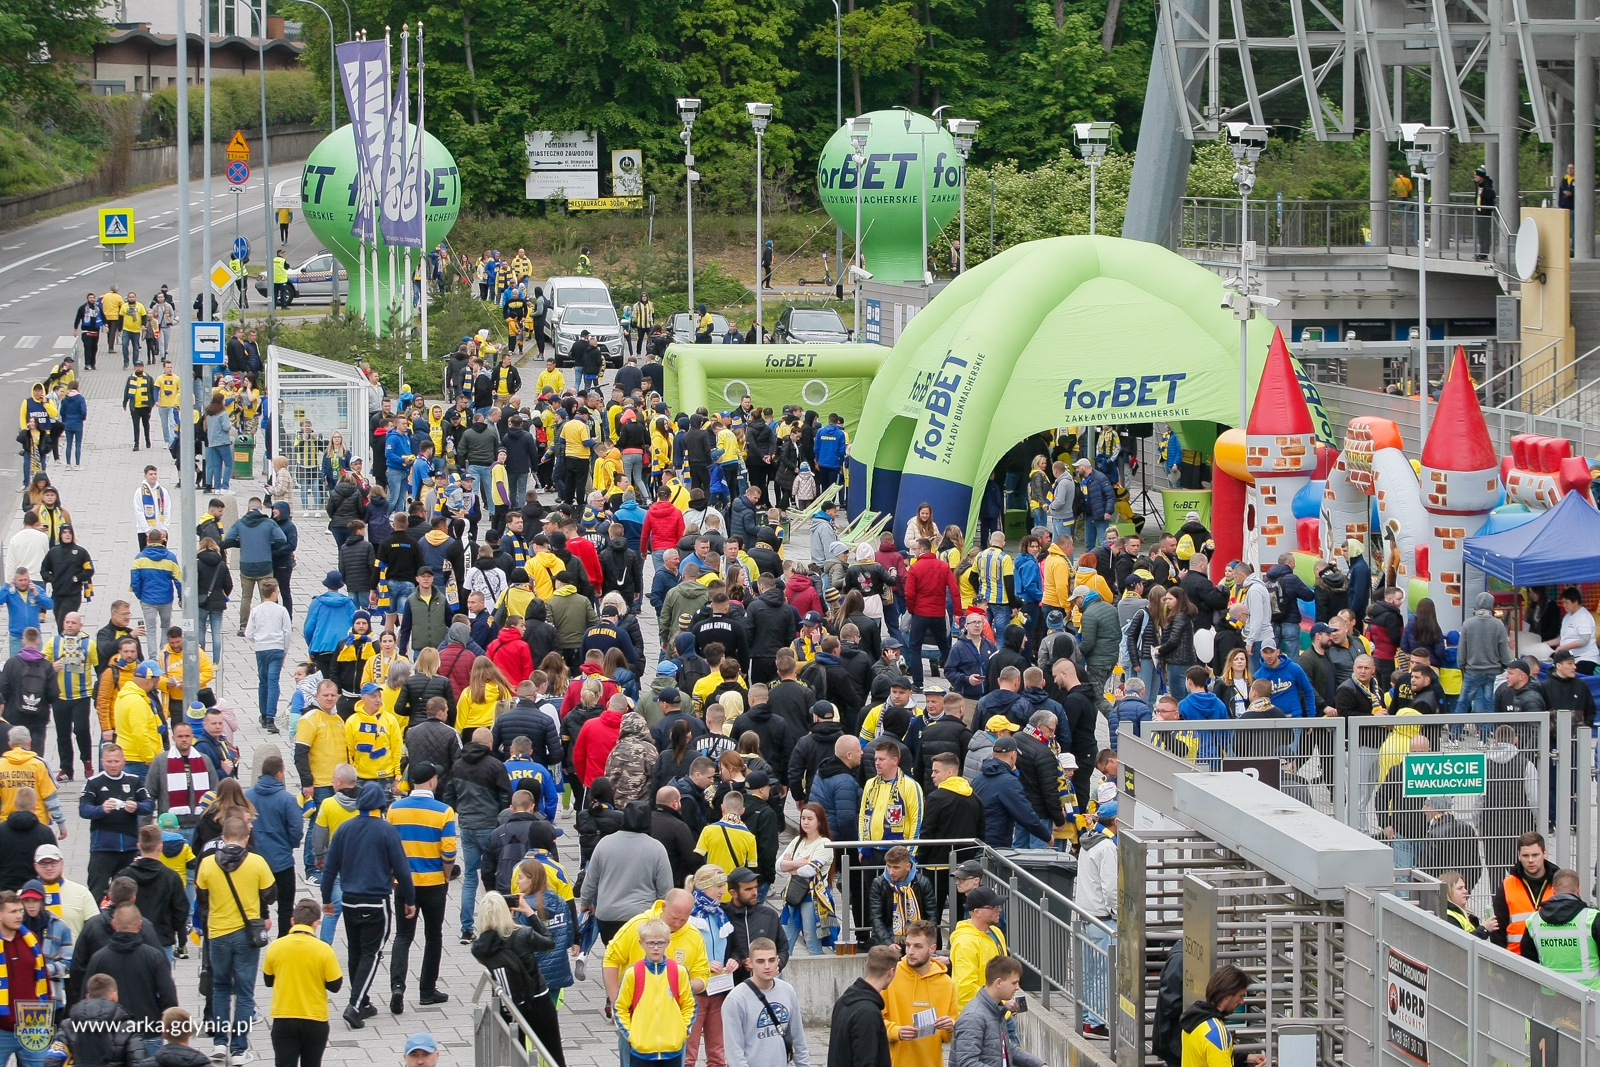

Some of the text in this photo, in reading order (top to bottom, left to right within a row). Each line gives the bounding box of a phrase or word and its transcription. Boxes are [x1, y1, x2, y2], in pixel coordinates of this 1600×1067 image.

[565, 149, 594, 157] ZAWODÓW
[765, 353, 818, 368] forBET
[1472, 352, 1487, 364] 14
[1063, 372, 1187, 410] forBET
[913, 349, 969, 462] forBET
[941, 352, 987, 465] ZAKŁADY BUKMACHERSKIE
[1065, 408, 1190, 423] ZAKŁADY BUKMACHERSKIE
[1172, 501, 1200, 509] forBET
[700, 622, 713, 632] ARKA
[1410, 759, 1480, 776] WYJŚCIE
[1407, 778, 1482, 789] EWAKUACYJNE
[1184, 935, 1204, 963] SEKTOR
[1540, 938, 1578, 948] EKOTRADE
[1399, 986, 1426, 1020] NORD
[1398, 1010, 1426, 1034] SECURITY
